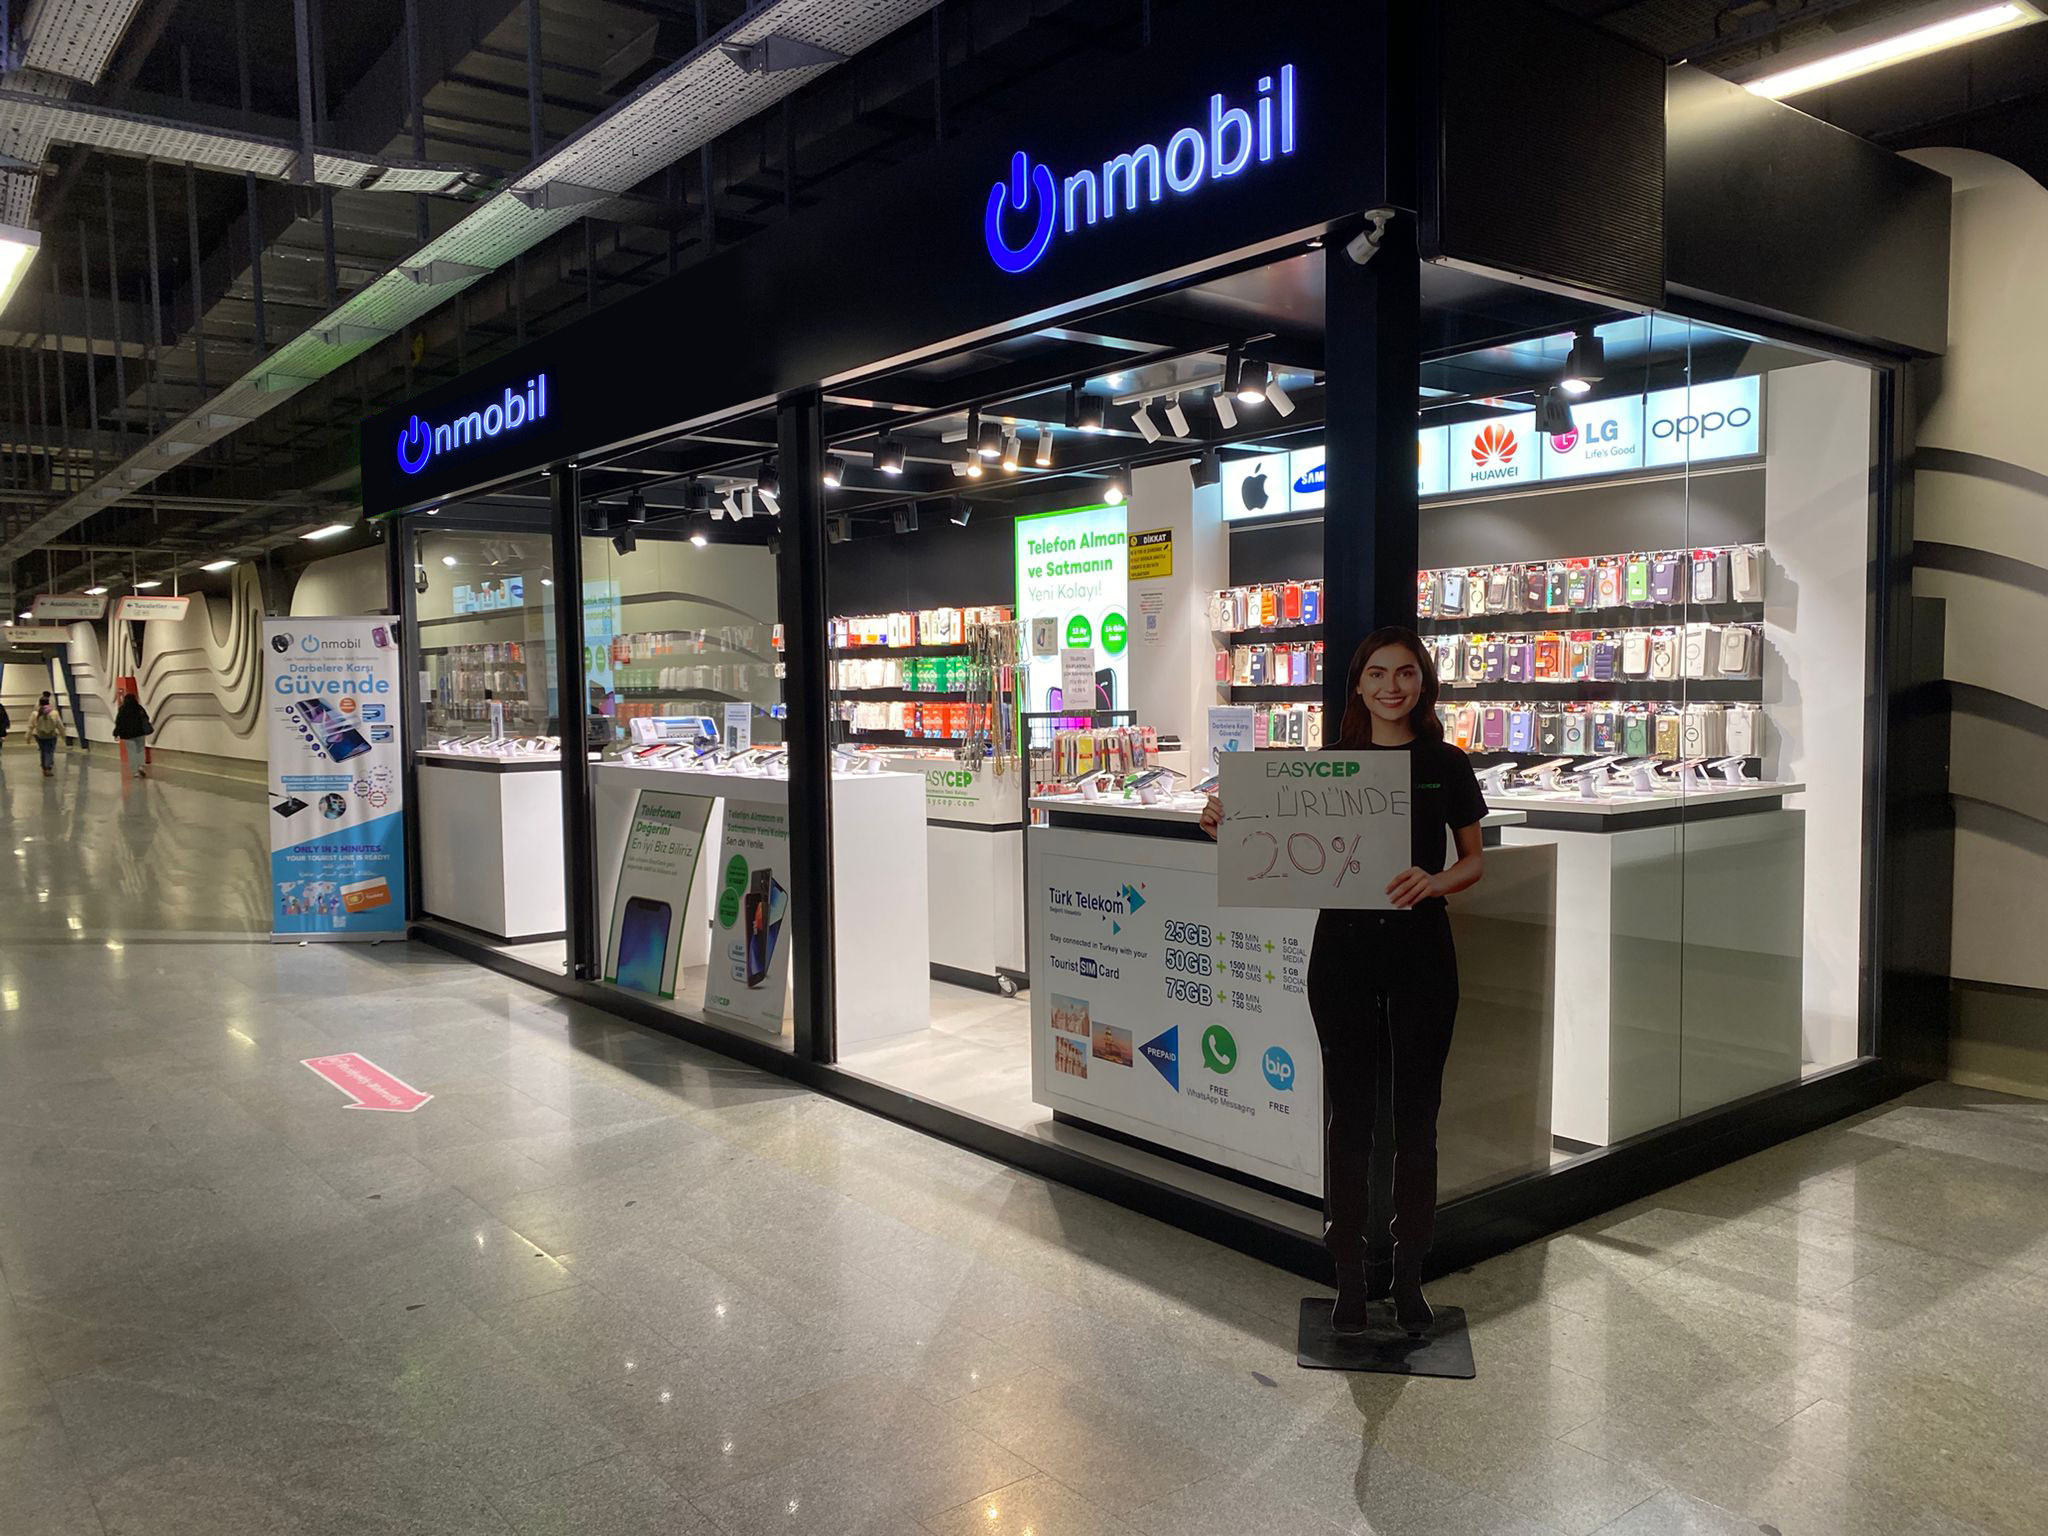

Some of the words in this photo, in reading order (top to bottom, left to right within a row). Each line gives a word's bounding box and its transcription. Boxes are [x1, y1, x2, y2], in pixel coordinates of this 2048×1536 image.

[1585, 419, 1618, 444] LG
[1652, 407, 1751, 442] oppo
[1585, 447, 1609, 460] Life's
[1610, 444, 1636, 456] Good
[1471, 466, 1518, 482] HUAWEI
[1028, 536, 1076, 555] Telefon
[1080, 531, 1127, 549] Alman
[1028, 566, 1043, 578] ve
[1046, 559, 1113, 577] Satmanın
[1028, 585, 1054, 601] Yeni
[1057, 580, 1102, 601] Kolayı!
[289, 663, 344, 673] Darbelere
[346, 663, 374, 674] Karşı
[275, 673, 390, 695] Güvende
[1266, 761, 1361, 778] EASYCEP
[925, 769, 973, 788] ASYCEP
[1276, 785, 1410, 818] ÜRÜNDE
[641, 804, 682, 820] Telefonun
[636, 821, 672, 837] Değerini
[631, 837, 641, 850] En
[654, 840, 667, 854] Biz
[1048, 887, 1073, 907] Türk
[1075, 891, 1124, 915] Telekom
[1165, 919, 1212, 948] 25GB
[1231, 931, 1244, 940] 750
[1245, 933, 1259, 943] MIN
[1050, 933, 1062, 944] Stay
[1062, 936, 1092, 948] connected
[1099, 942, 1119, 955] Turkey
[1119, 947, 1133, 955] with
[1133, 950, 1149, 959] your
[1231, 939, 1244, 949] 750
[1245, 941, 1262, 953] SMS
[1288, 938, 1298, 946] GB
[1283, 945, 1307, 957] SOCIAL
[1283, 953, 1304, 964] MEDIA
[1050, 955, 1079, 973] Tourist
[1080, 958, 1097, 977] SIM
[1098, 964, 1120, 980] Card
[1165, 948, 1213, 976] 50GB
[1229, 960, 1246, 970] 1500
[1247, 963, 1261, 973] MIN
[1231, 969, 1244, 979] 750
[1245, 971, 1262, 983] SMS
[1288, 968, 1299, 976] GB
[1283, 975, 1308, 987] SOCIAL
[1283, 983, 1305, 994] MEDIA
[1165, 977, 1213, 1007] 75GB
[1231, 991, 1245, 1000] 750
[1246, 993, 1260, 1004] MIN
[1231, 1000, 1245, 1010] 750
[1245, 1002, 1263, 1013] SMS
[1147, 1047, 1177, 1062] PREPAID
[1209, 1084, 1229, 1097] FREE
[1186, 1087, 1219, 1106] WhatsApp
[1220, 1097, 1256, 1116] Messaging
[1269, 1101, 1290, 1115] FREE
